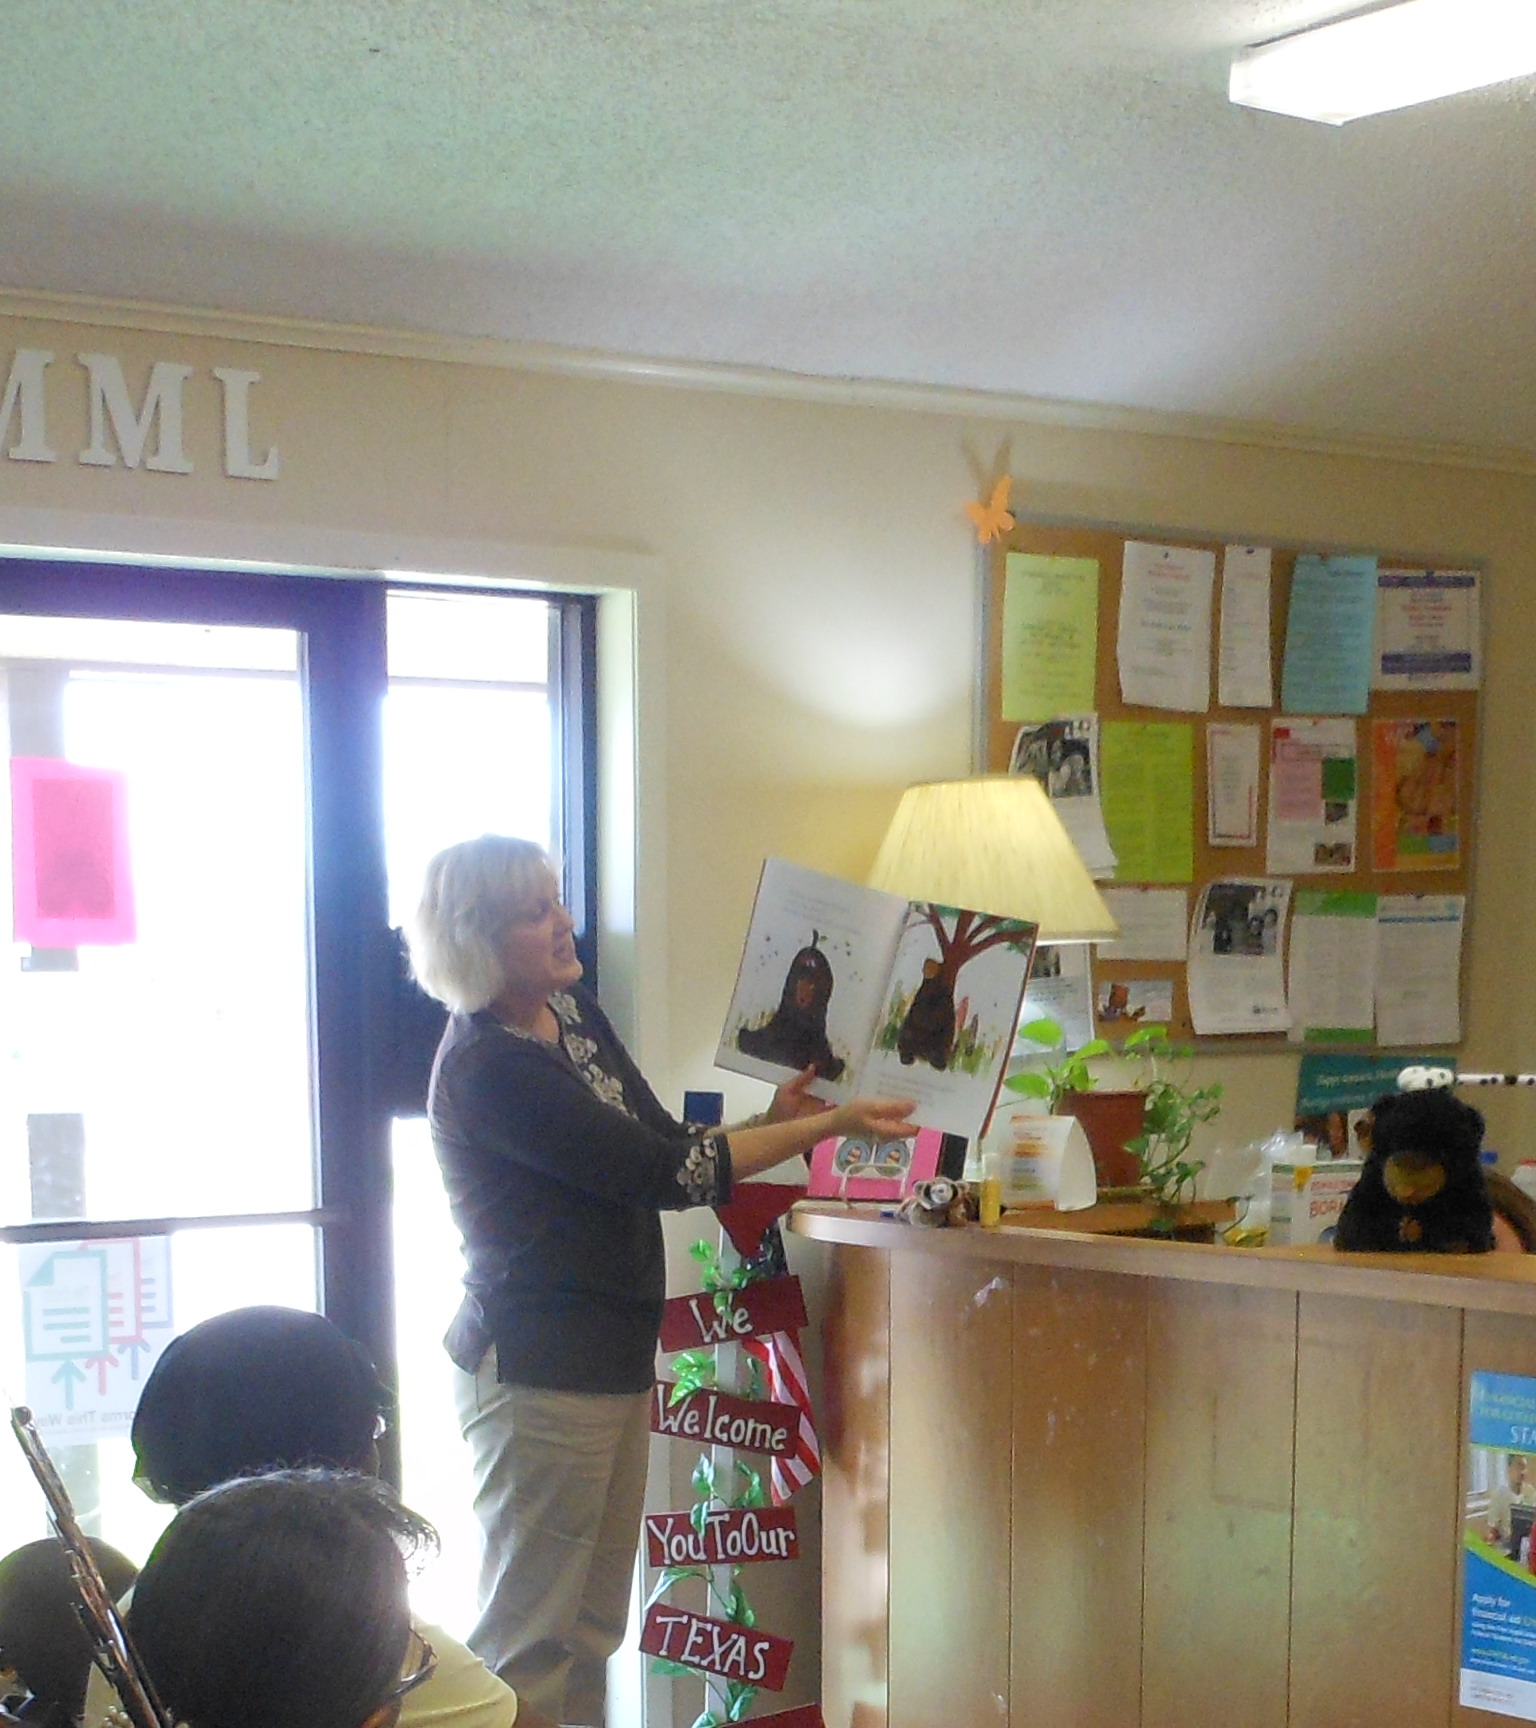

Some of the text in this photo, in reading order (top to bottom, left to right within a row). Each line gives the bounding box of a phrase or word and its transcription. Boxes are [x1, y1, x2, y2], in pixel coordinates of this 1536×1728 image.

[690, 1300, 755, 1345] We
[657, 1384, 789, 1452] Welcome
[655, 1616, 771, 1682] TEXAS
